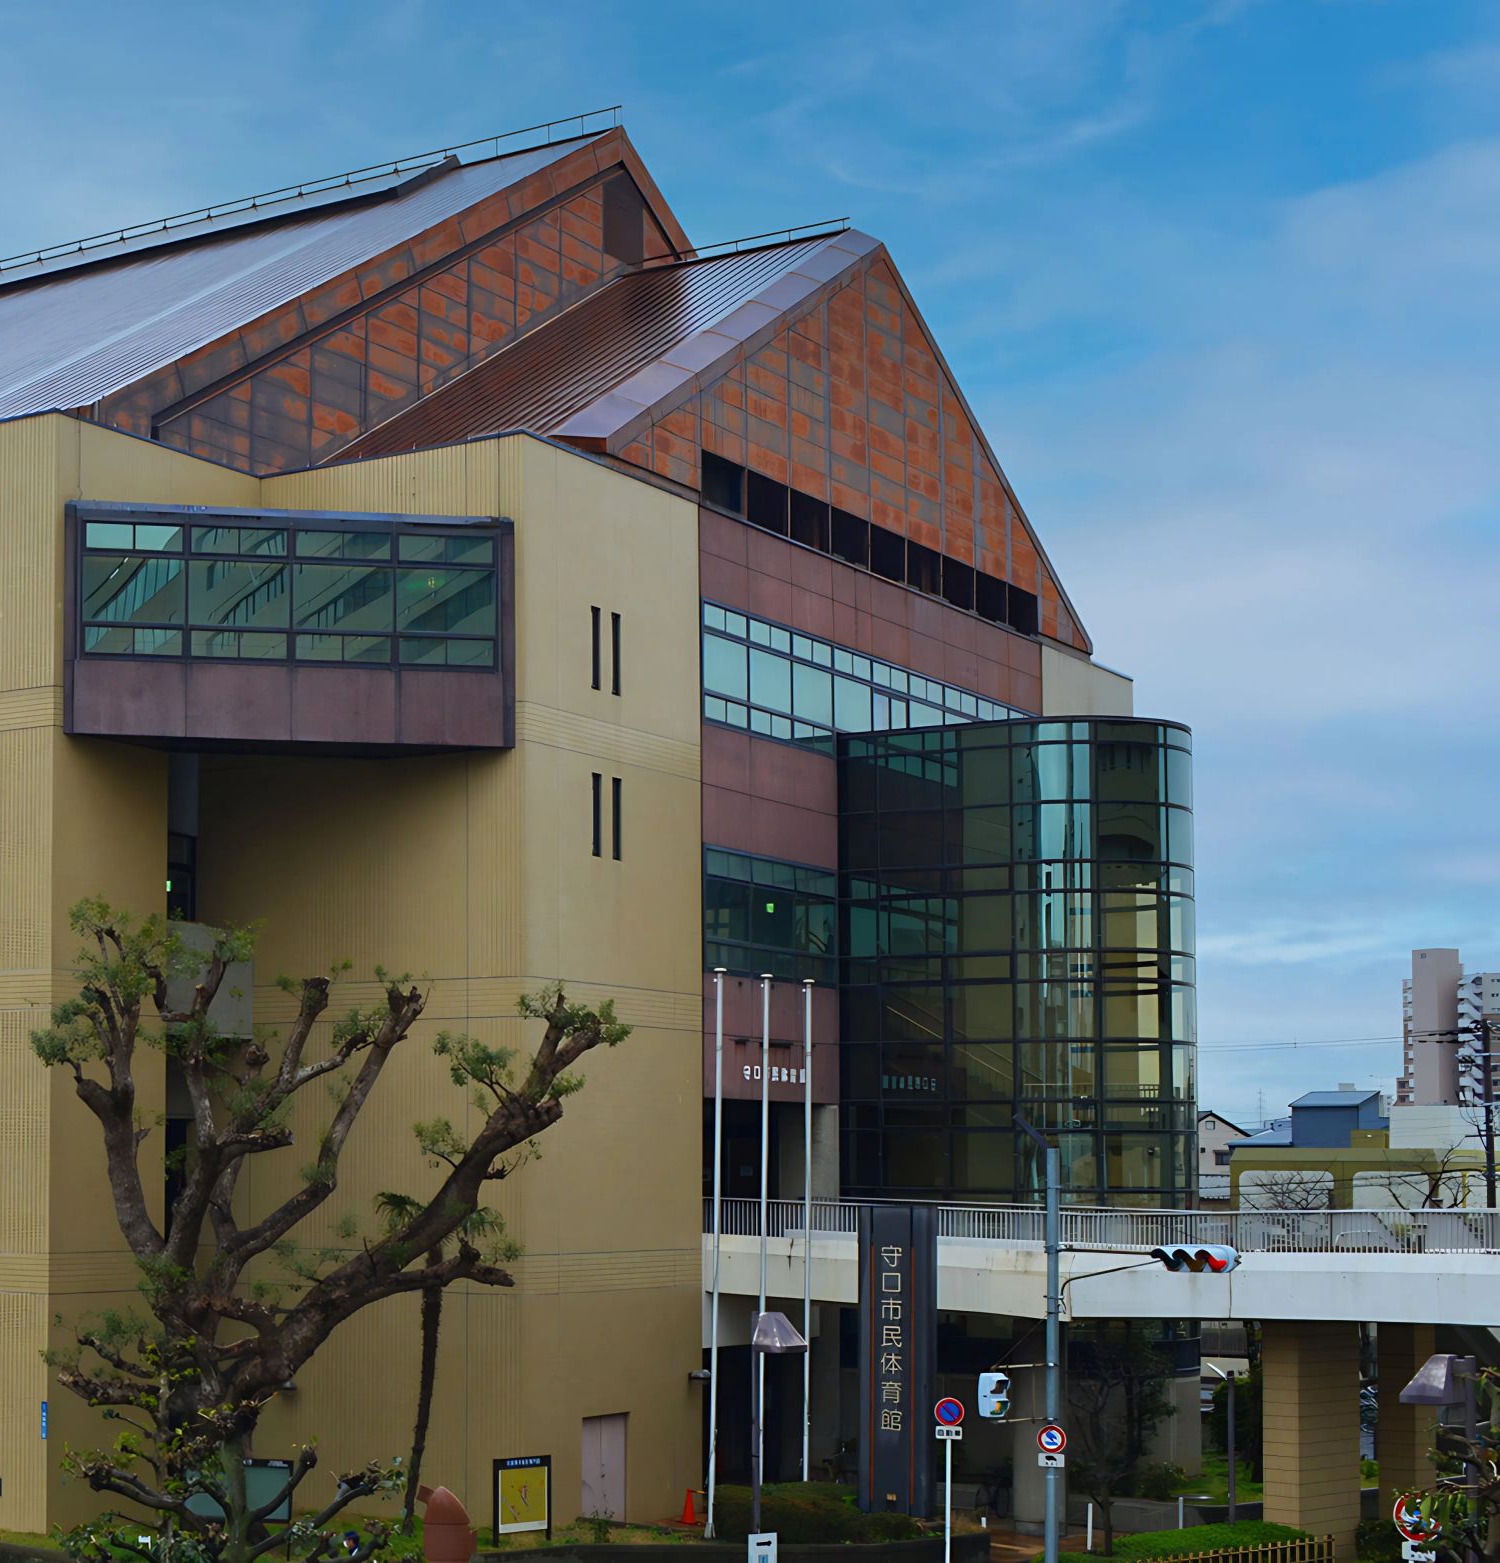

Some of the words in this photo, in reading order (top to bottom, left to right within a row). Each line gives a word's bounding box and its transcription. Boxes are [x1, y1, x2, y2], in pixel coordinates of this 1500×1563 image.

[880, 1245, 903, 1431] 守口市民体育館
